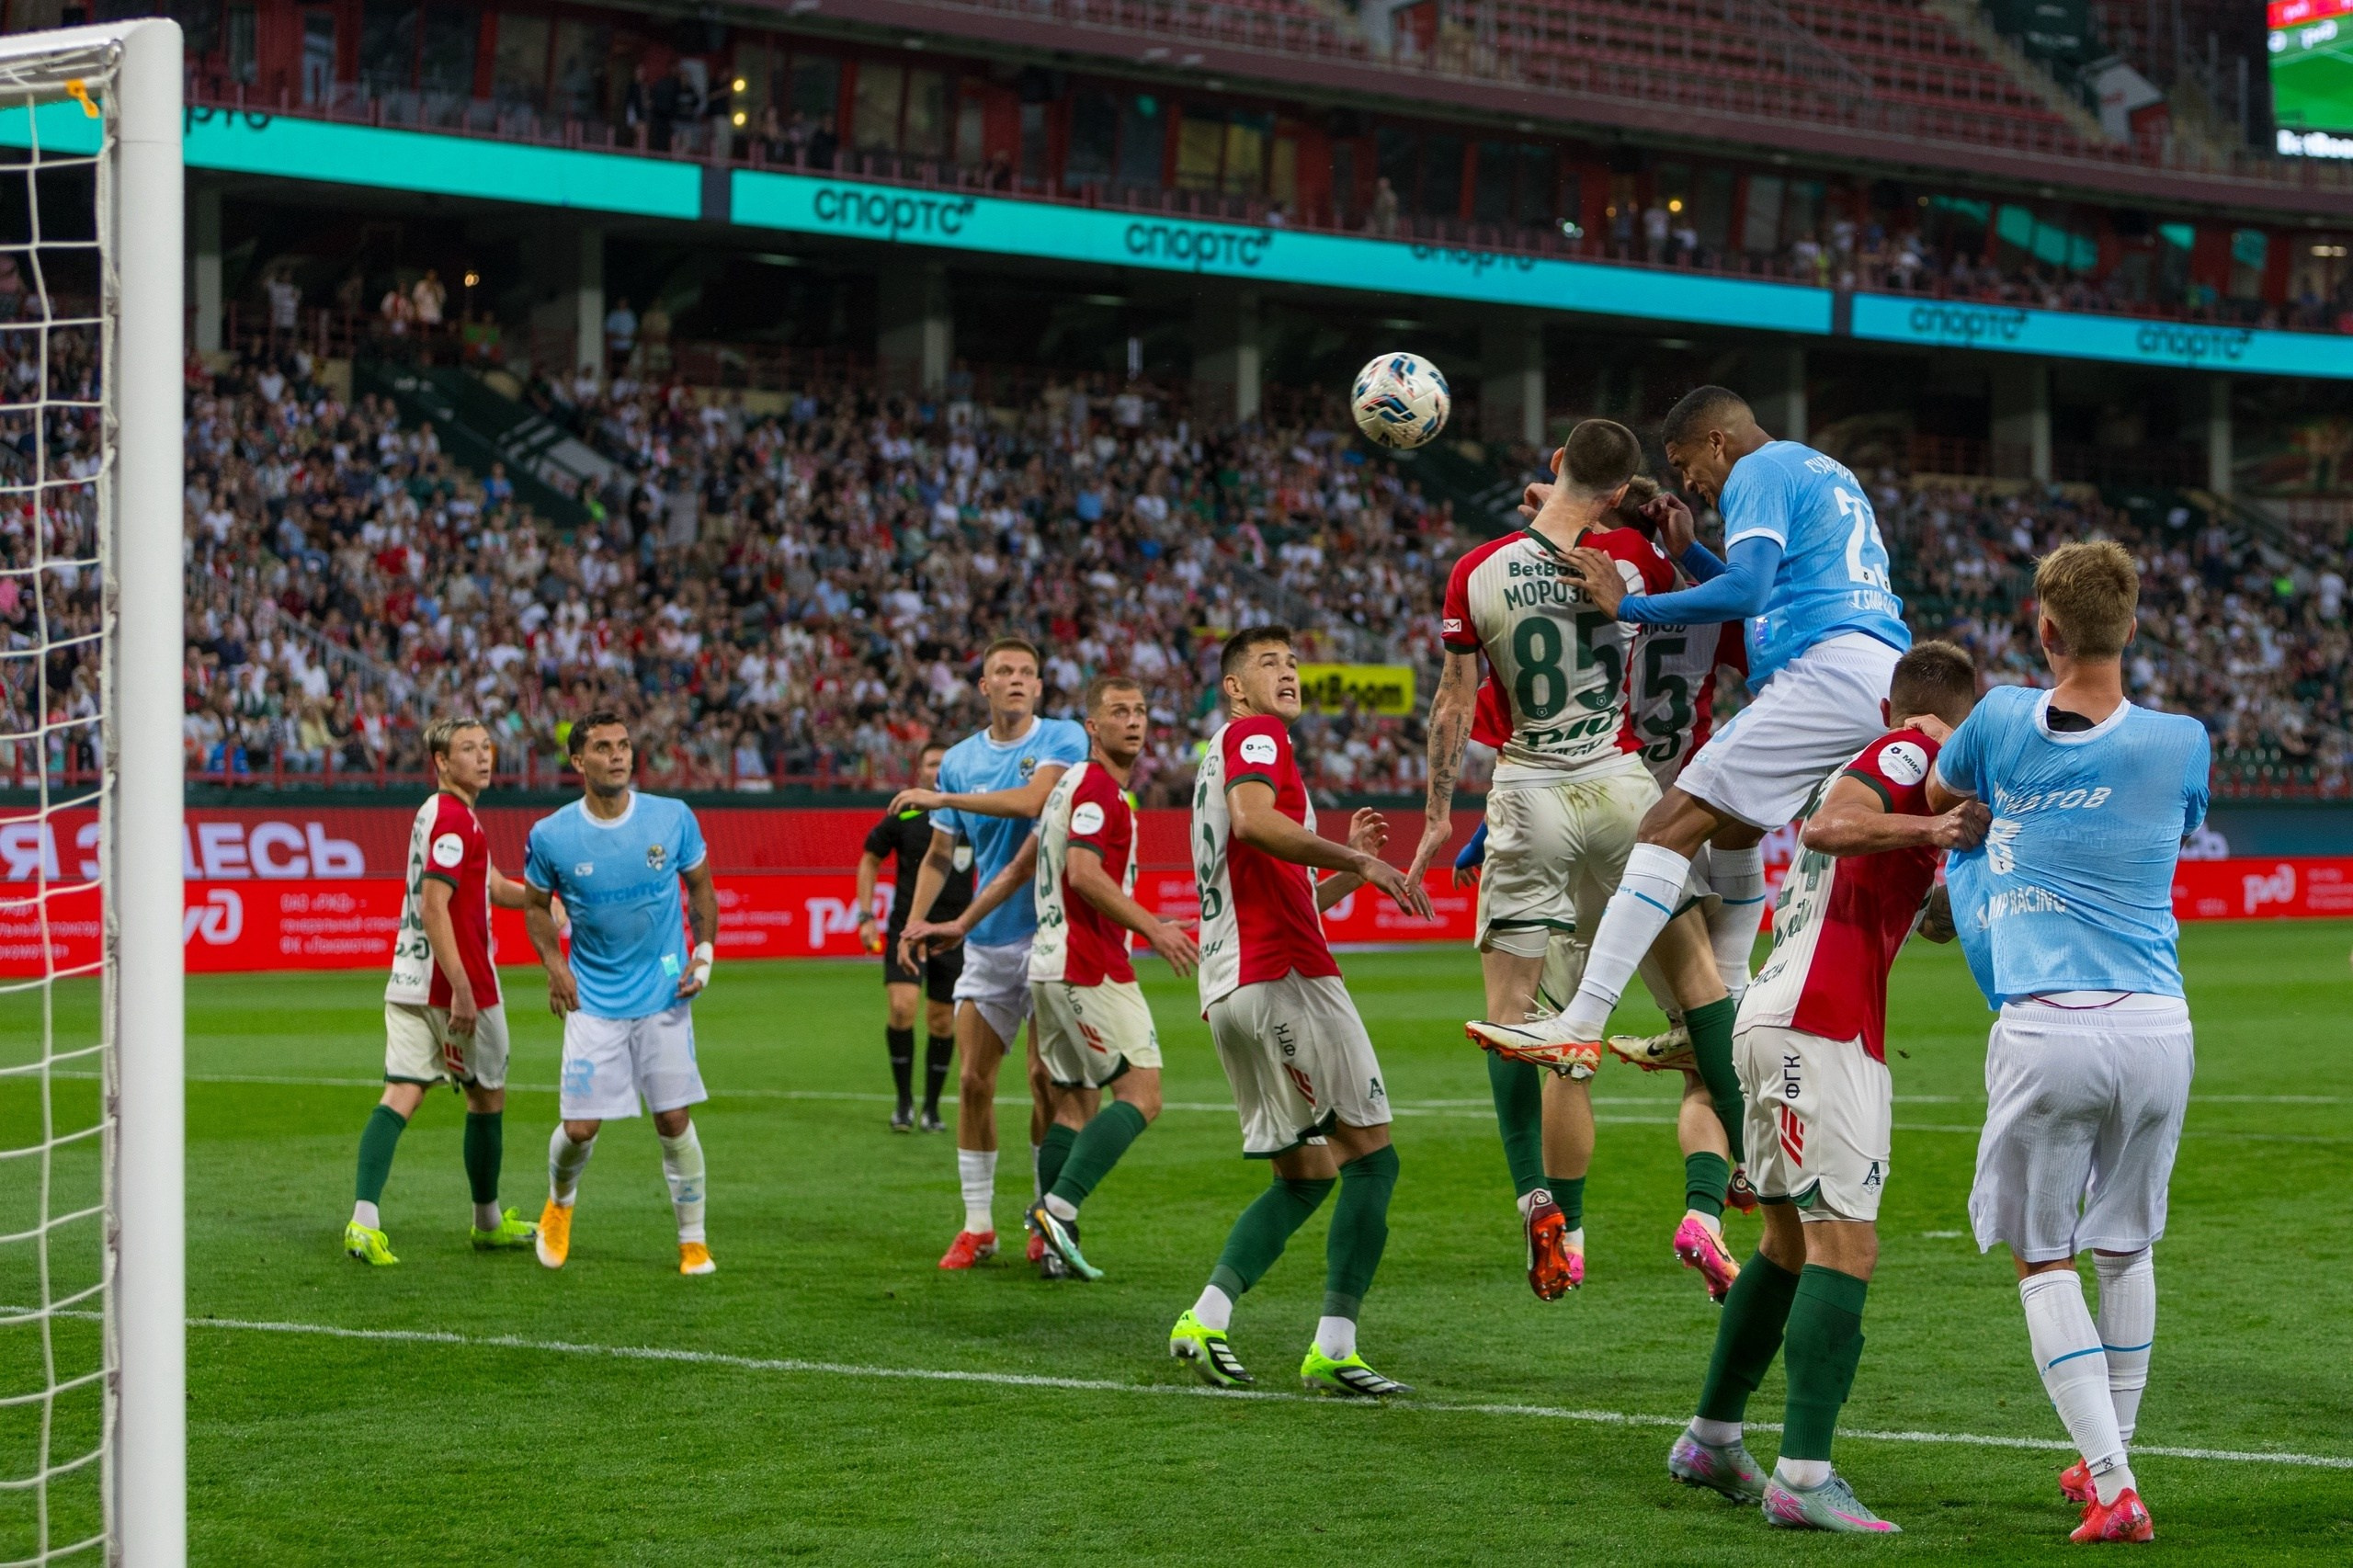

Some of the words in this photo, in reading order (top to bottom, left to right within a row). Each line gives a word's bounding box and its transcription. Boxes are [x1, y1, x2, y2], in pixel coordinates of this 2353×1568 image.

[1508, 562, 1587, 578] BetBoo
[1504, 580, 1596, 612] МОРОЗО
[1514, 610, 1622, 721] 85
[1299, 673, 1404, 707] etBoom
[1902, 754, 1922, 775] МИР
[76, 822, 366, 881] ЗЕСЬ
[1274, 1022, 1296, 1057] ФГК
[1784, 1053, 1802, 1100] ФГК
